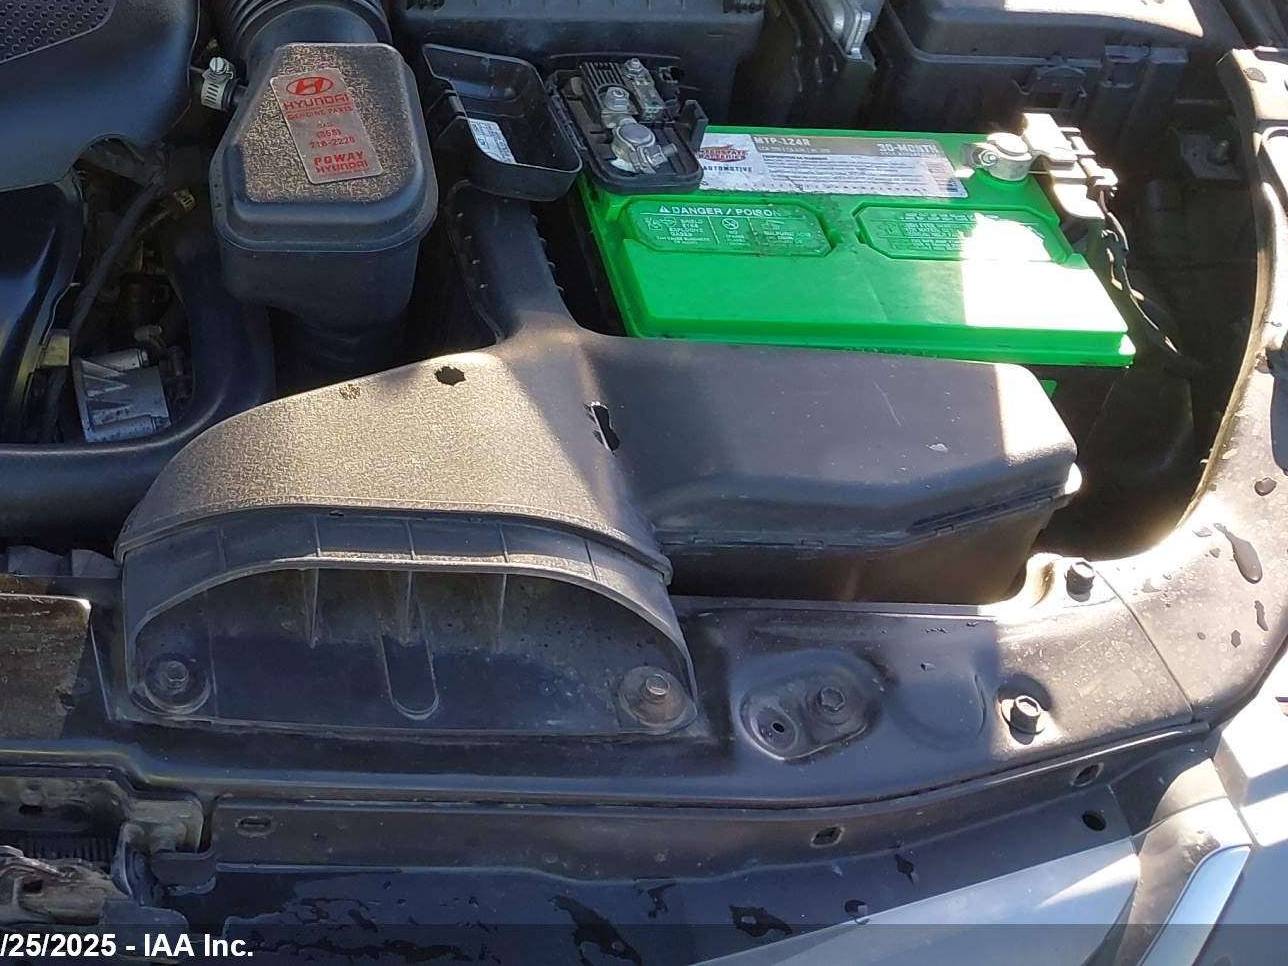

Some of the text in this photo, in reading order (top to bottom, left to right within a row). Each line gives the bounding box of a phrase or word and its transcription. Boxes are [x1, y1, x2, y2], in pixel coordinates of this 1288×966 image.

[284, 94, 349, 110] HYUNDAI
[327, 105, 354, 114] PARTS
[876, 142, 939, 153] 30-MONTH
[314, 150, 364, 166] POWAY
[315, 160, 369, 173] HYUNDAI
[703, 165, 752, 173] AUTOMOTIVE
[671, 206, 723, 215] DANGER
[735, 208, 782, 217] POISON
